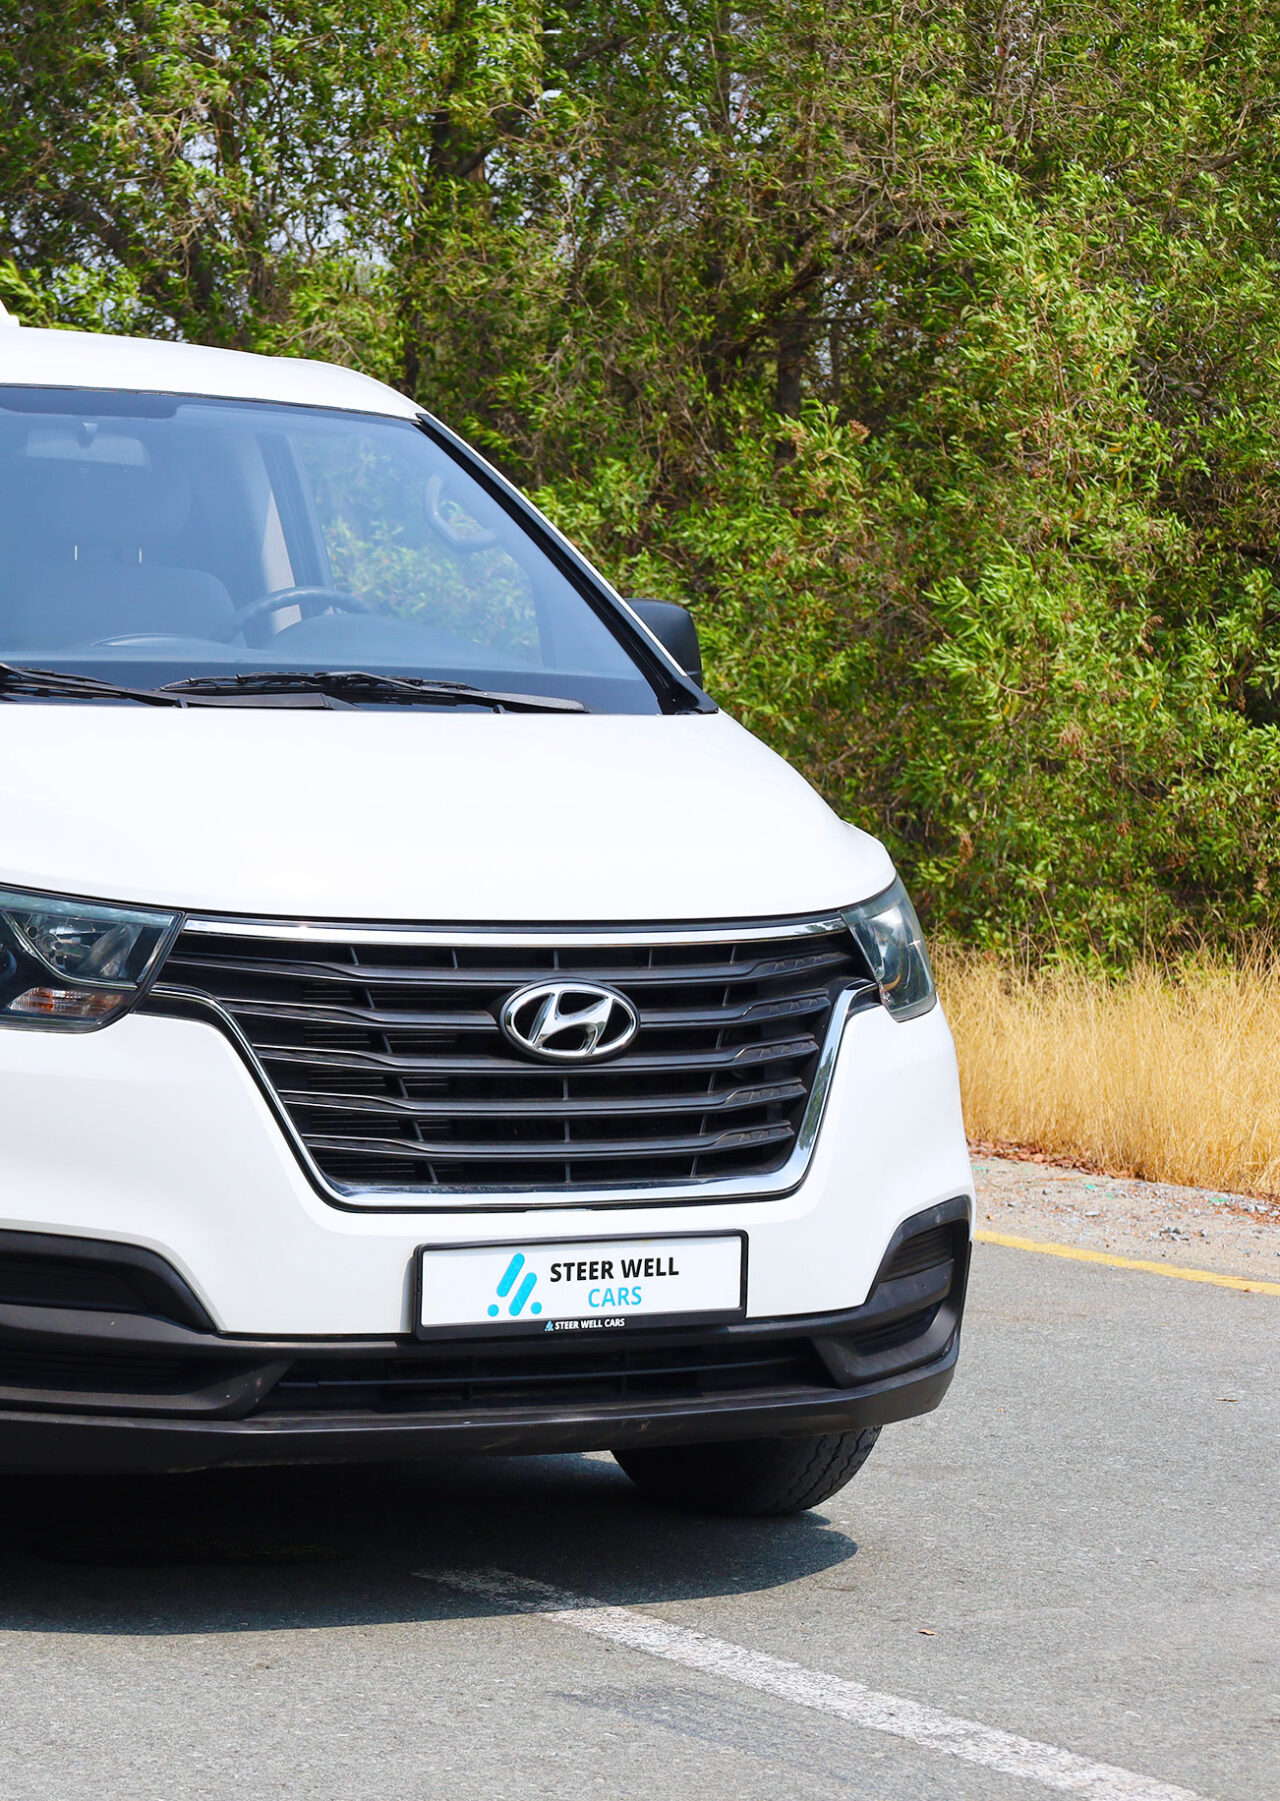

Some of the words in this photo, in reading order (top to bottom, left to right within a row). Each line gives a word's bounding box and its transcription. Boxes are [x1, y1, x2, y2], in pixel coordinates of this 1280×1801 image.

[549, 1260, 614, 1282] STEER
[620, 1256, 680, 1278] WELL
[587, 1285, 642, 1308] CARS
[554, 1320, 579, 1330] STEER
[580, 1319, 603, 1329] WELL
[604, 1318, 625, 1328] CARS
